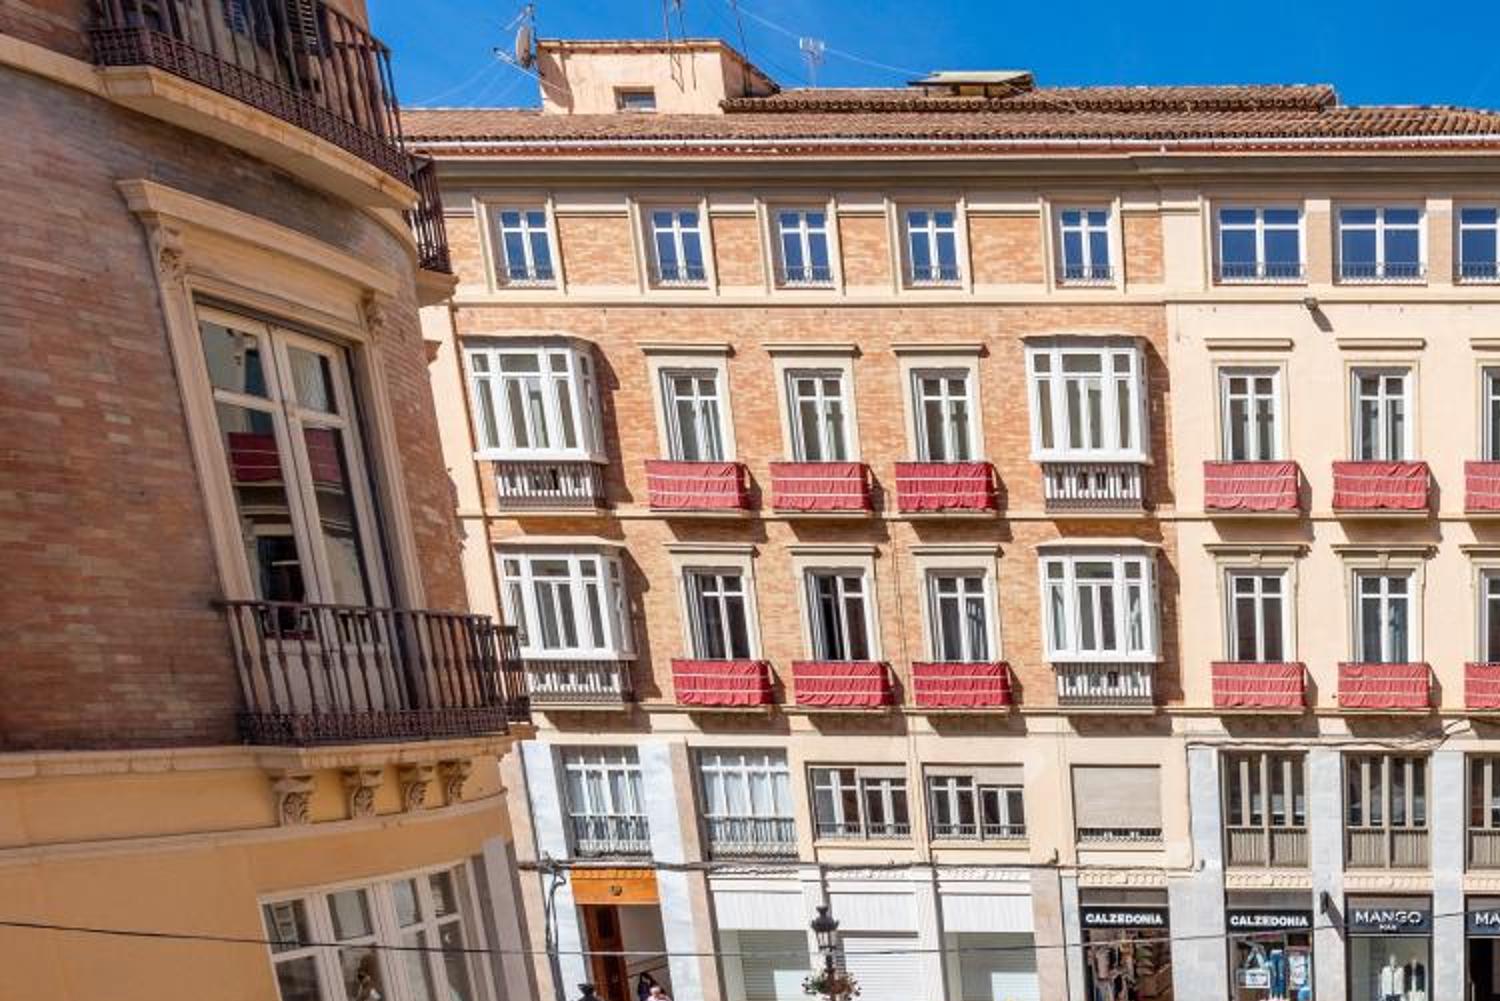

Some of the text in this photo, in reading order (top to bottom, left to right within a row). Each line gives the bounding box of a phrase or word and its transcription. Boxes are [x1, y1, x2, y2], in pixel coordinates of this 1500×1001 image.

[1085, 913, 1163, 925] CALZEDONIA
[1230, 915, 1309, 927] CALZEDONIA
[1355, 911, 1422, 924] MANGO
